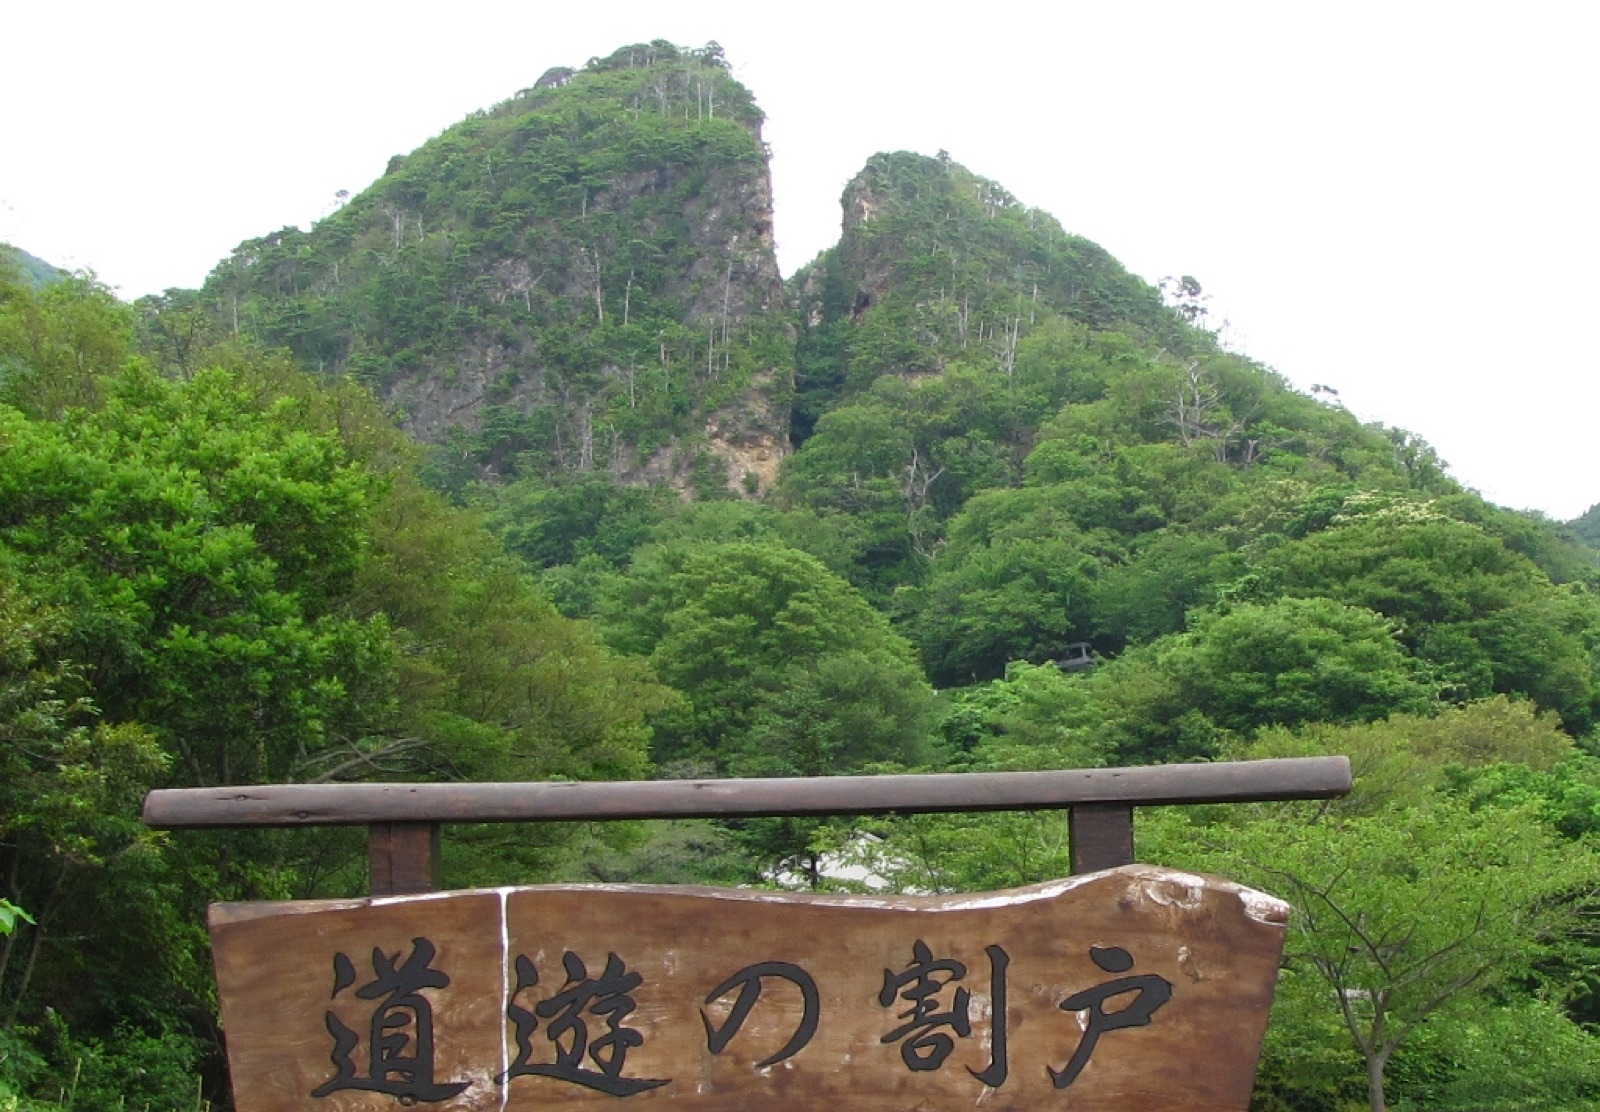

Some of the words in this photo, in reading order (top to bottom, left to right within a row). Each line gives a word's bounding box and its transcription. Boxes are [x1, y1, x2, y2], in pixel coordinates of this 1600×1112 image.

[311, 937, 1174, 1101] 道遊の割戸
